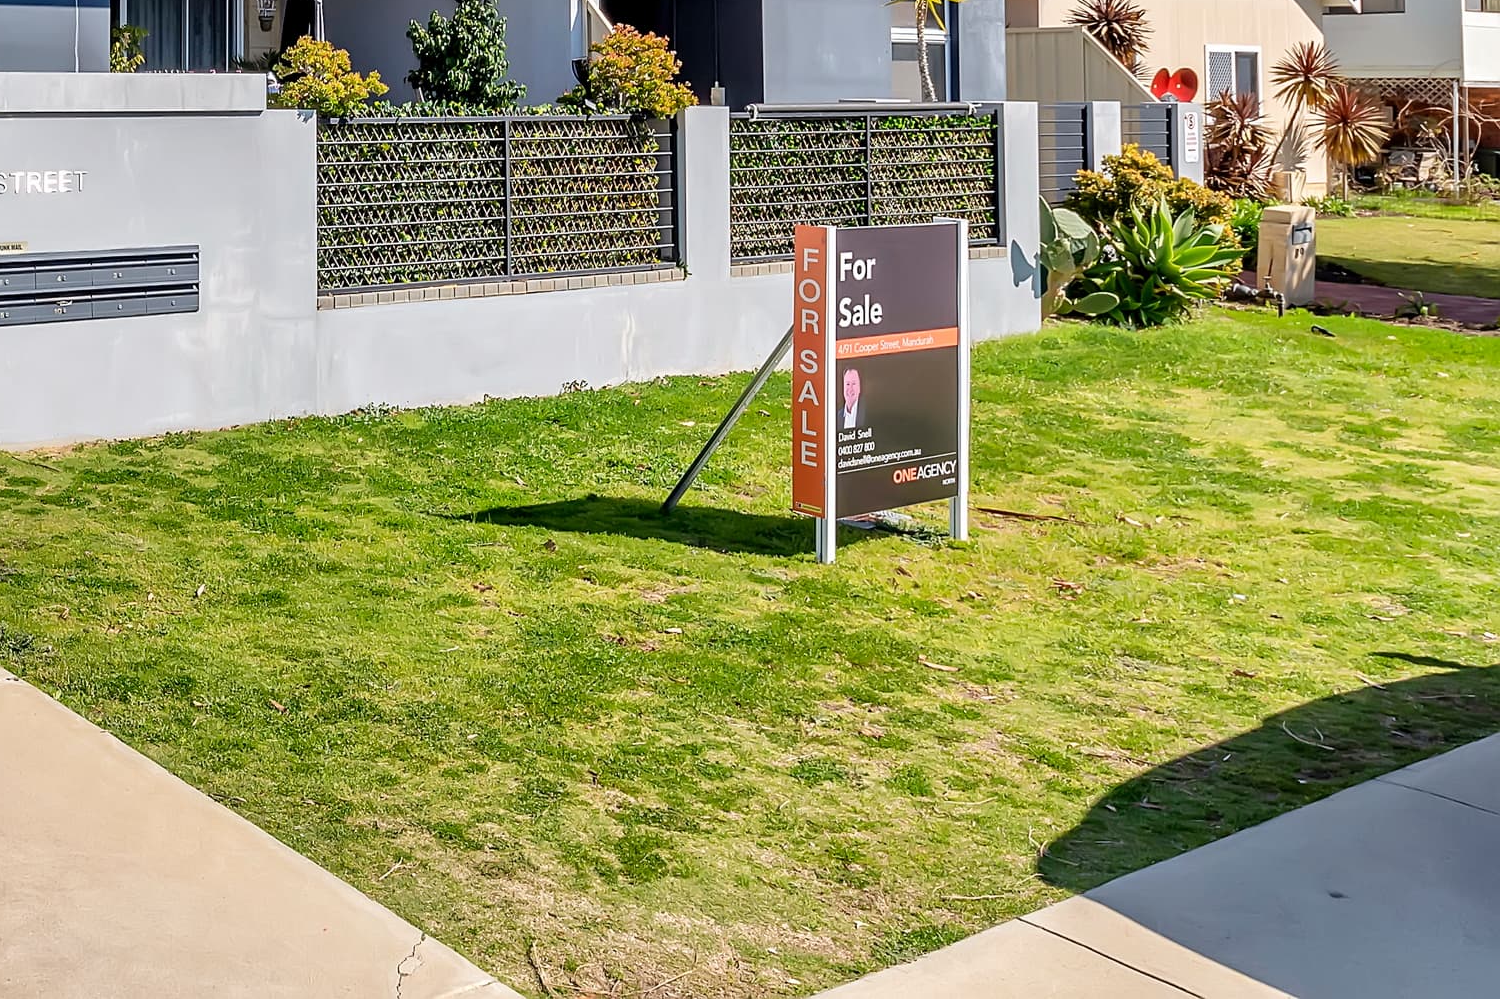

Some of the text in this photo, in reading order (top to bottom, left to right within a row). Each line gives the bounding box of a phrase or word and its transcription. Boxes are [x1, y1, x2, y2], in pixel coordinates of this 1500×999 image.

[11, 243, 23, 251] MAIL
[839, 252, 876, 282] For
[798, 248, 821, 335] FOR
[838, 294, 883, 328] Sale
[837, 334, 934, 354] 4/91 Cooper Street, Mandurah
[798, 349, 820, 468] SALE
[838, 427, 873, 442] David Snell
[838, 445, 853, 457] 0400
